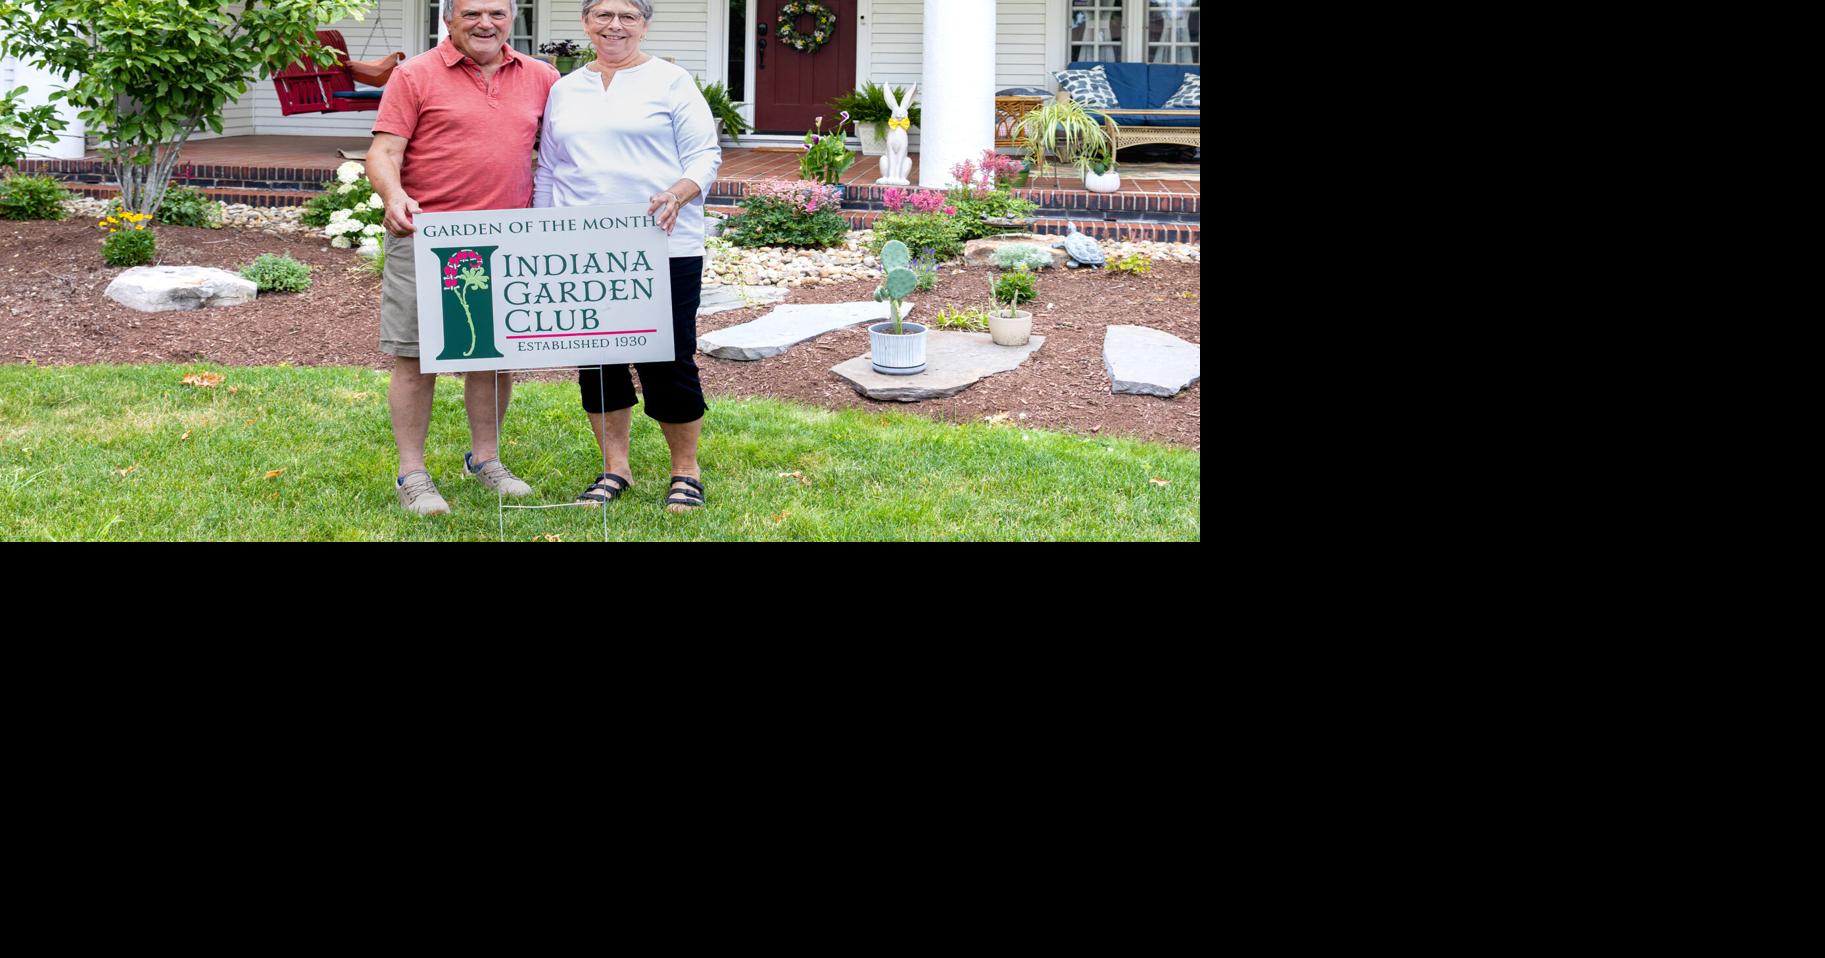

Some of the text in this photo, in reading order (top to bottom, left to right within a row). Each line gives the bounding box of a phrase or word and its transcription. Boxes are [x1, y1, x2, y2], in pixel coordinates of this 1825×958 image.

[423, 215, 656, 238] GARDEN OF THE MONTH
[503, 250, 654, 278] INDIANA
[503, 277, 654, 306] GARDEN
[504, 308, 600, 333] CLUB
[517, 335, 647, 352] ESTABLISHED 1930
